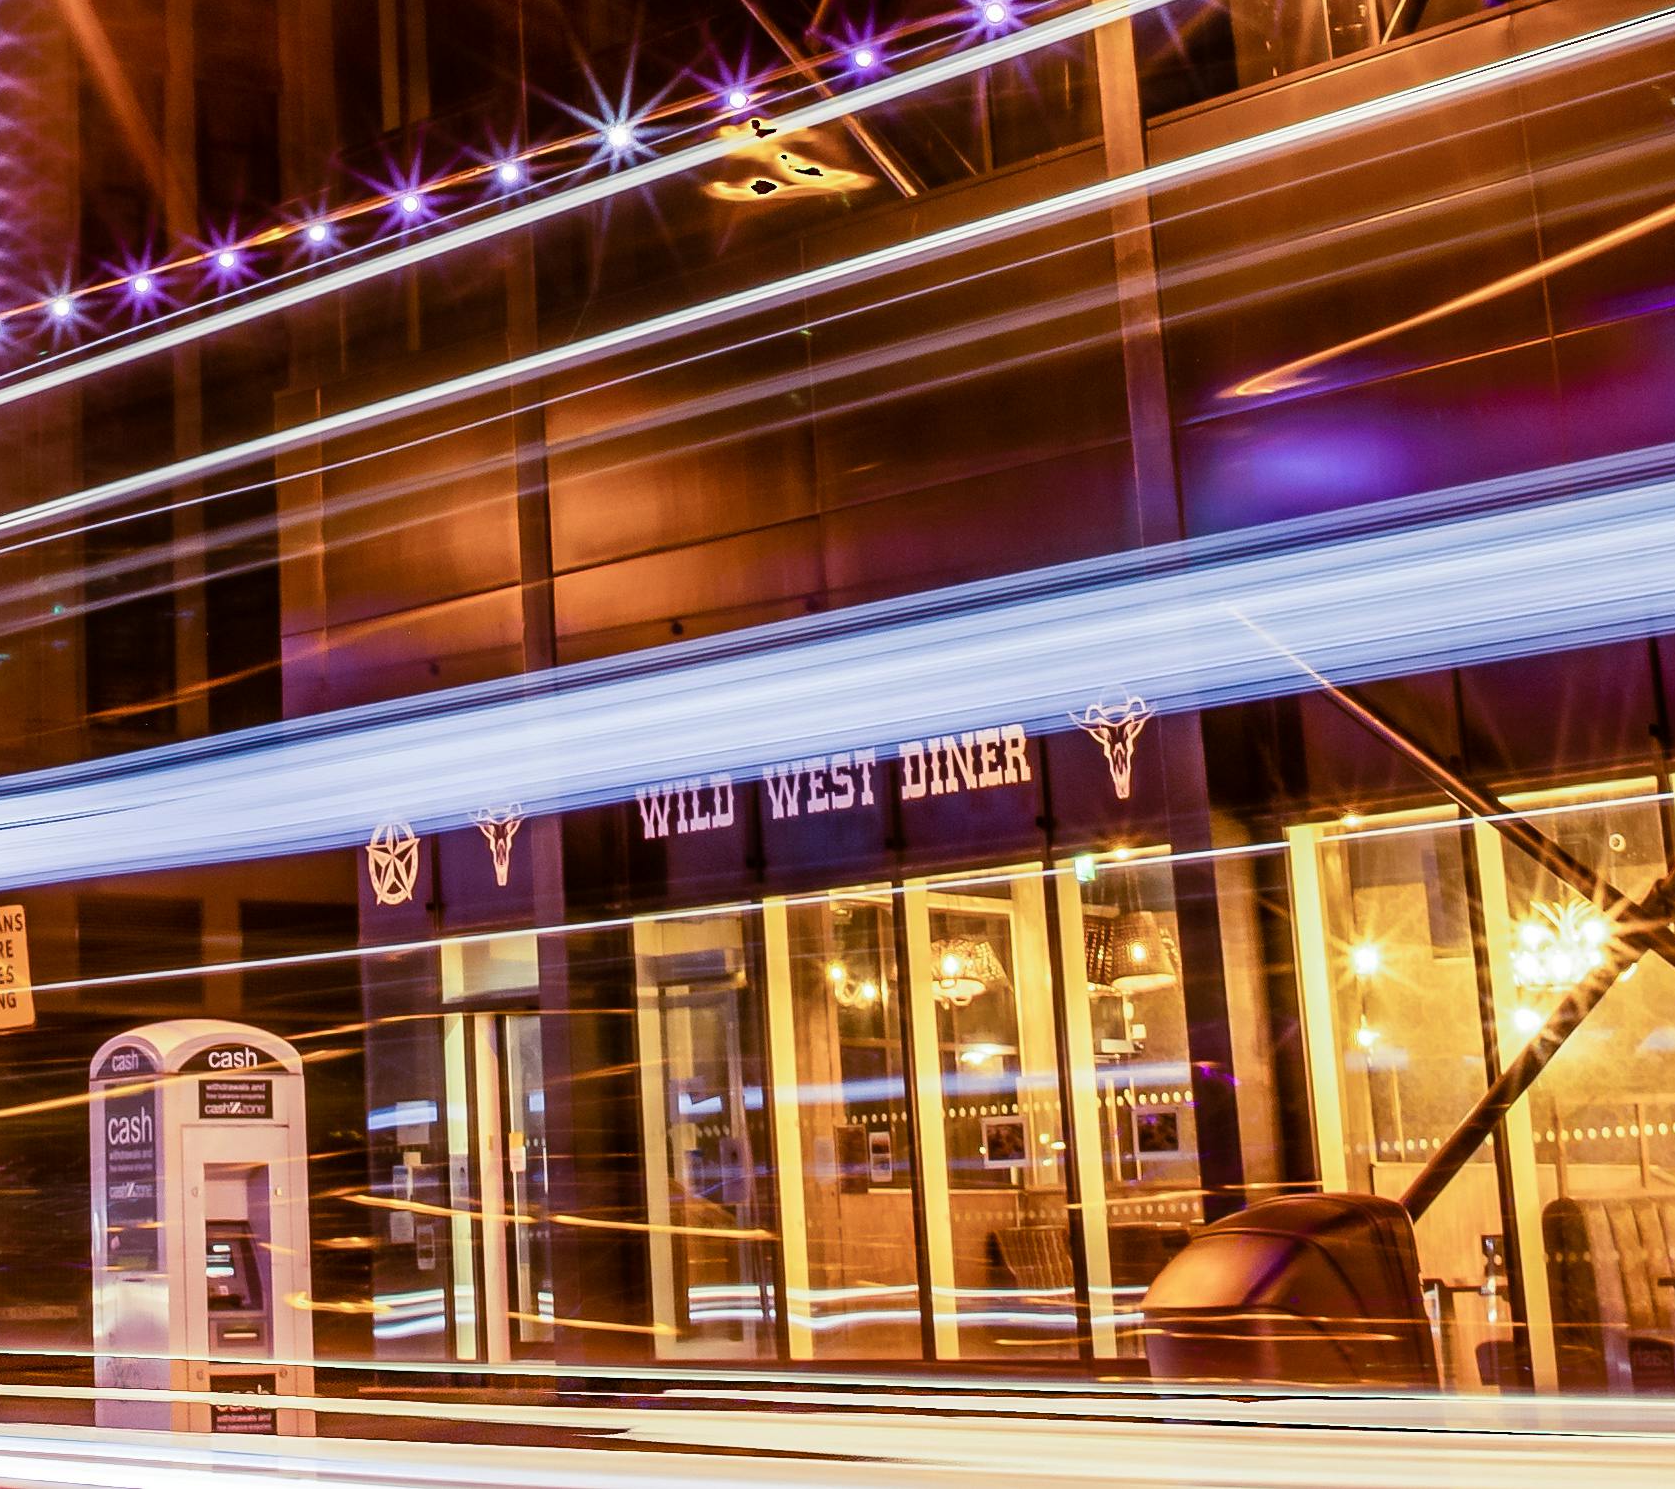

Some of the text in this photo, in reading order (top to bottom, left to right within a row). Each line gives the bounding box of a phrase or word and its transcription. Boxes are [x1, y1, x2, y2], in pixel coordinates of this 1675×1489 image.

[635, 724, 1032, 840] WILD WEST DINER
[112, 1050, 139, 1072] cash
[208, 1047, 258, 1069] cash
[107, 1106, 153, 1146] cash
